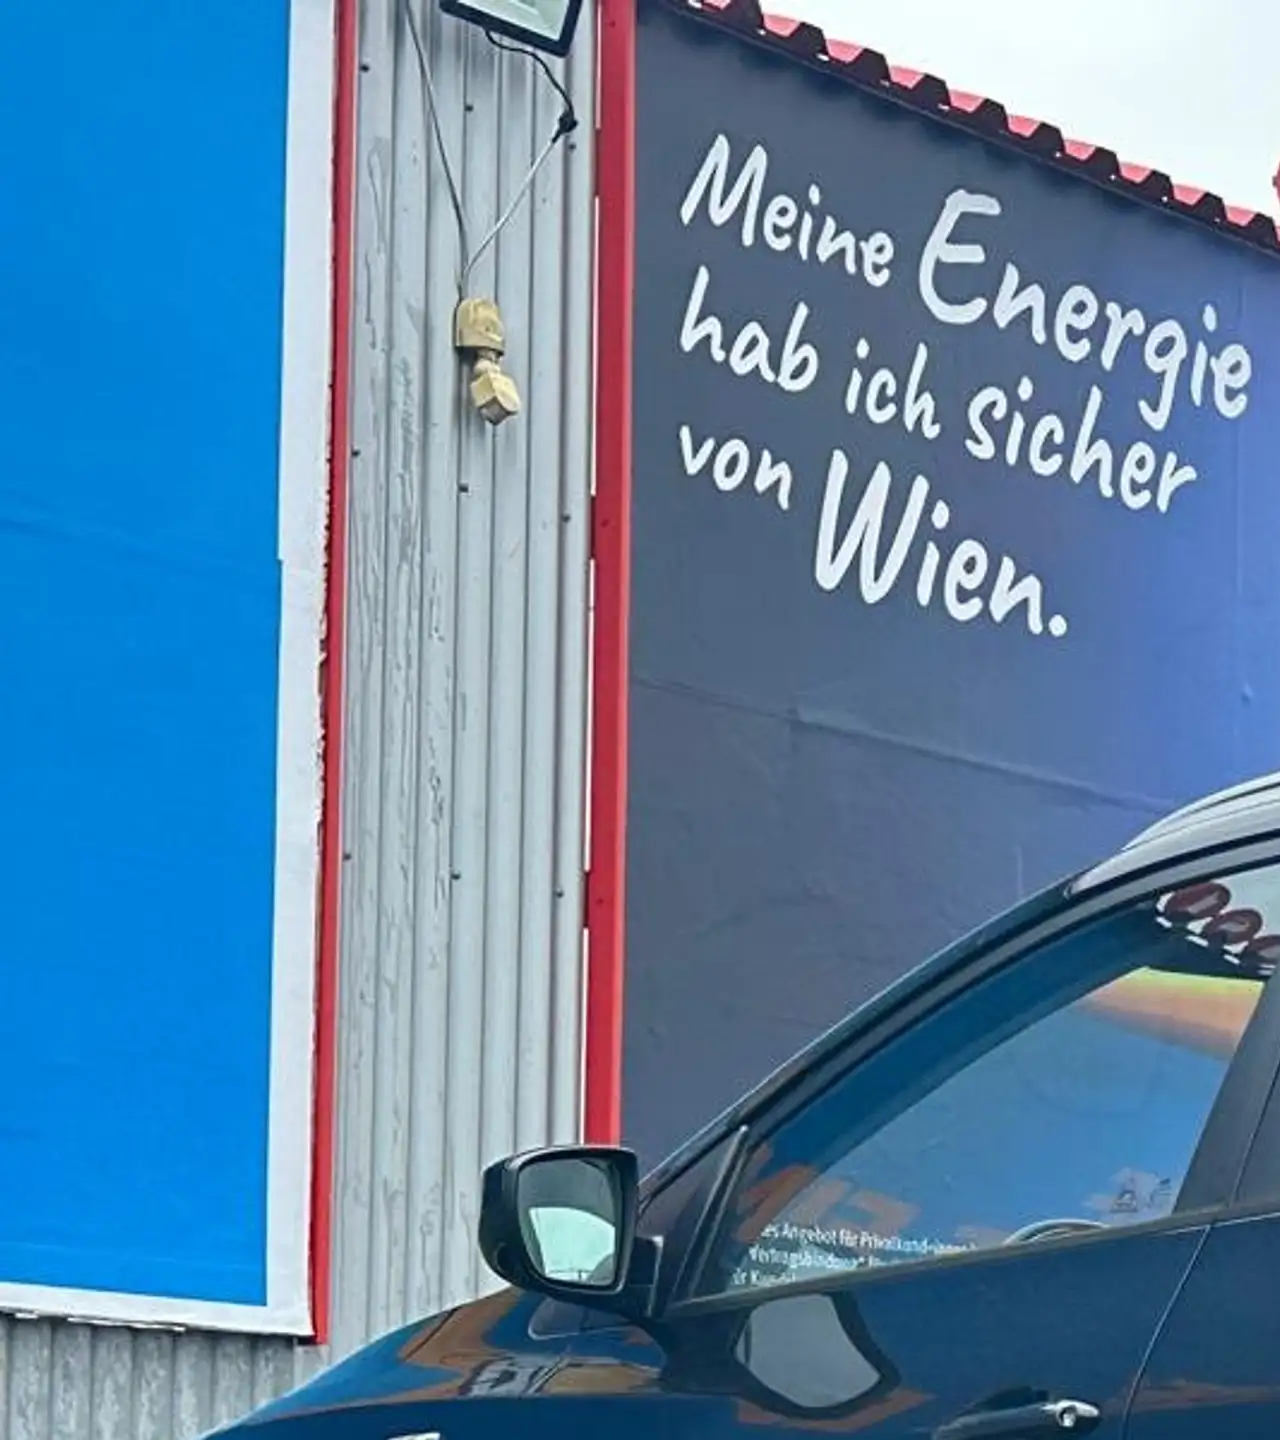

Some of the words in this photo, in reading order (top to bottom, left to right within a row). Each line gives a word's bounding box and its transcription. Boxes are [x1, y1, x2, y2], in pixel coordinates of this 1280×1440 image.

[679, 265, 819, 392] hab
[845, 338, 942, 439] ich
[965, 376, 1197, 514] sicher
[681, 133, 895, 288] Meine
[920, 188, 1252, 431] Energie
[679, 425, 790, 511] von
[814, 449, 1069, 638] Wien.
